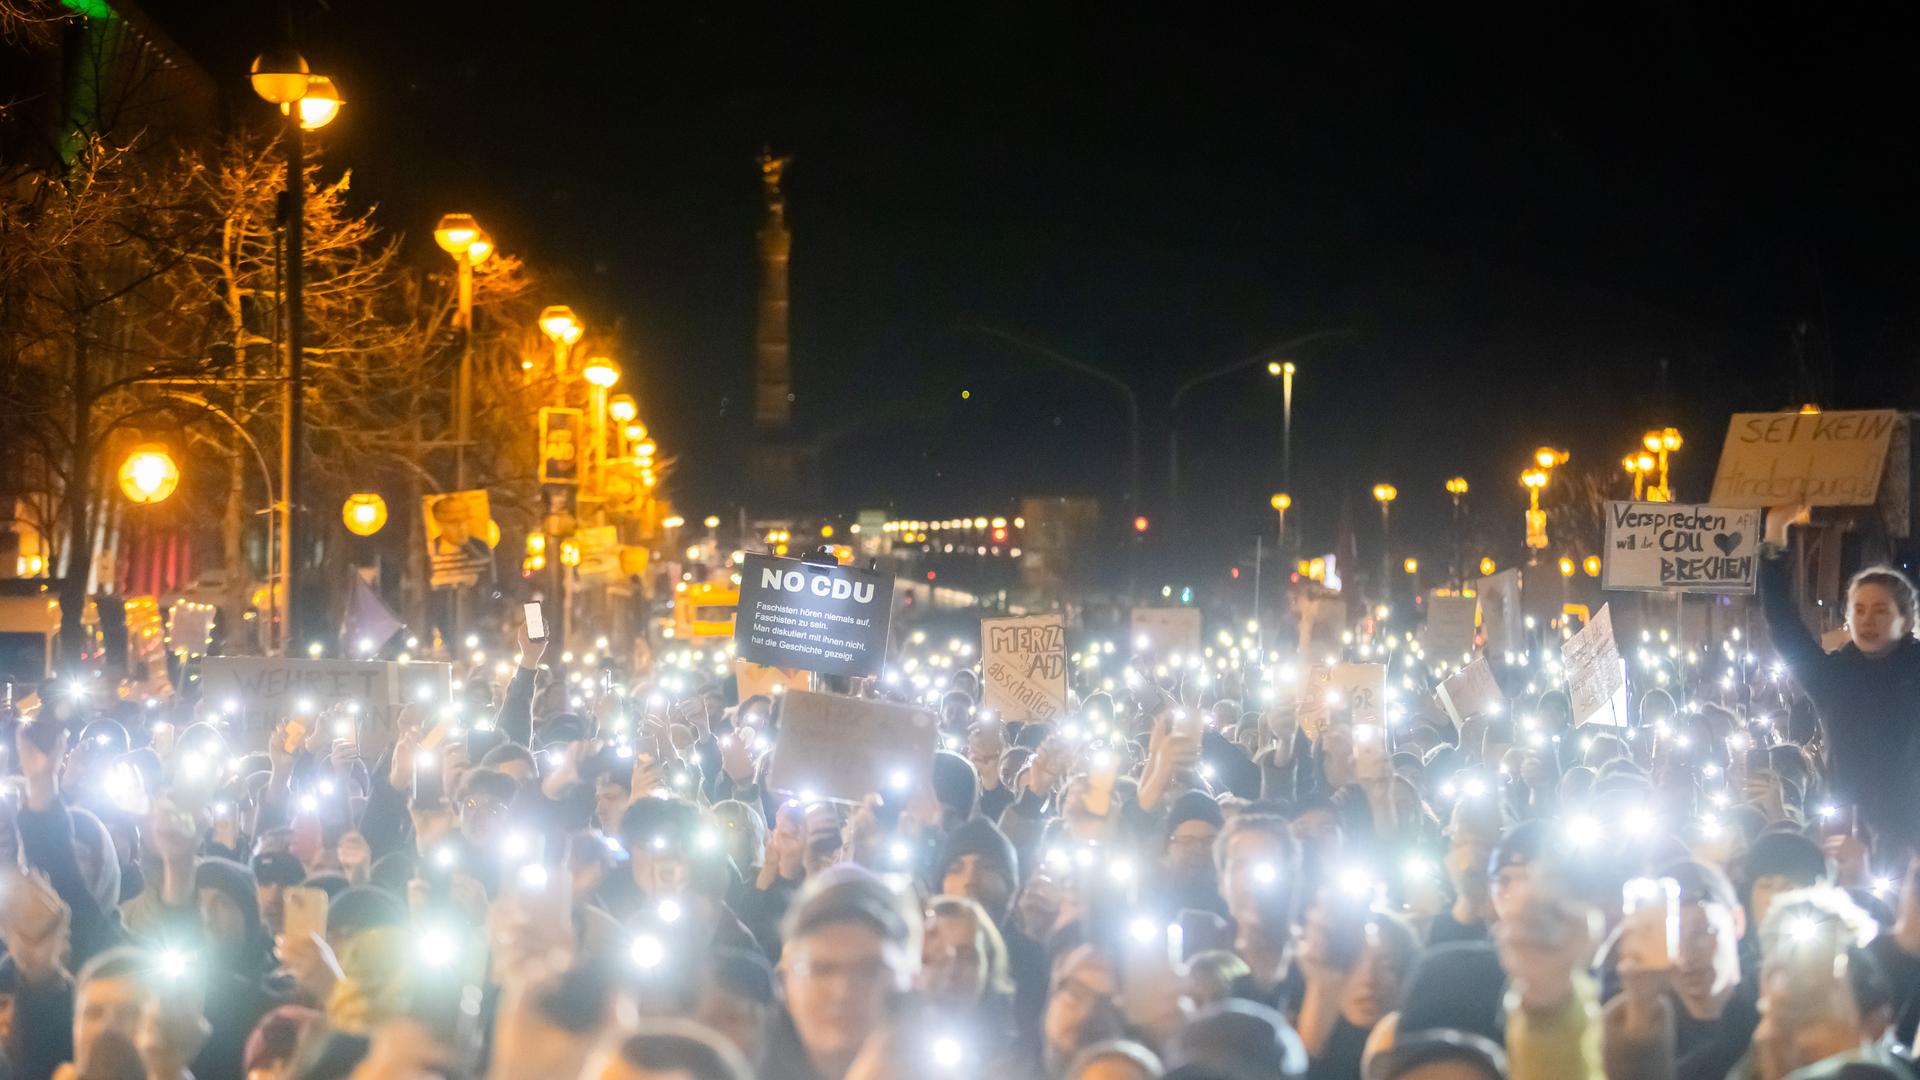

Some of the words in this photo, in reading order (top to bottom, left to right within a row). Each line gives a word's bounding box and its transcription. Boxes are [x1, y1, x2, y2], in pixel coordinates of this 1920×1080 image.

[1739, 414, 1800, 445] SEI
[1812, 414, 1894, 442] KEIN
[1613, 503, 1726, 535] Versprechen
[1616, 534, 1636, 550] will
[1658, 530, 1704, 553] CDU
[1660, 556, 1752, 583] BRECHEN
[761, 568, 805, 593] NO
[810, 575, 875, 604] CDU
[754, 612, 797, 626] Faschisten
[798, 620, 809, 628] zu
[756, 601, 799, 616] Faschisten
[800, 608, 823, 619] hören
[824, 613, 855, 625] niemals
[751, 635, 764, 645] hat
[765, 638, 777, 647] die
[779, 641, 823, 655] Geschichte
[753, 623, 770, 634] Man
[772, 627, 807, 640] diskutiert
[808, 632, 821, 642] mit
[991, 626, 1064, 653] MERZ
[1026, 653, 1064, 681] AfD
